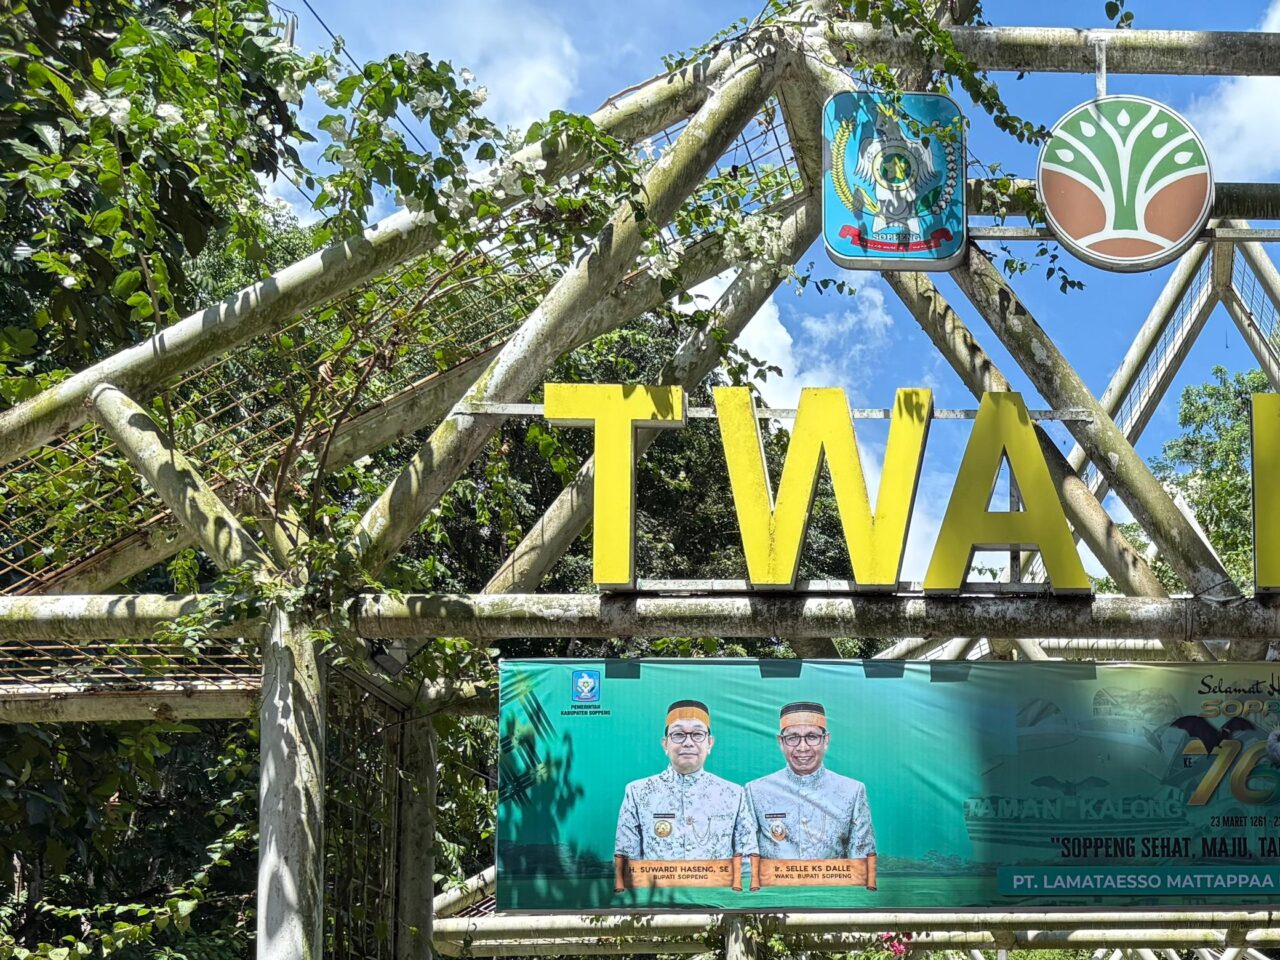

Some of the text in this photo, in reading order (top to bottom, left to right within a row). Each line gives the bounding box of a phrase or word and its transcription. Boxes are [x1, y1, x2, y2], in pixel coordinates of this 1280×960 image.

[543, 382, 1094, 594] TWA
[1198, 674, 1266, 695] Selamat
[1210, 816, 1221, 827] 23
[1222, 816, 1248, 827] MARET
[1250, 816, 1267, 827] 1261
[1050, 836, 1136, 859] "SOPPENG
[1141, 836, 1197, 860] SEHAT,
[1201, 836, 1253, 860] MAJU,
[680, 865, 716, 874] HASENG,
[719, 865, 730, 873] SE
[1013, 874, 1038, 889] PT.
[1043, 874, 1162, 889] LAMATAESSO
[1166, 873, 1275, 889] MATTAPPAA
